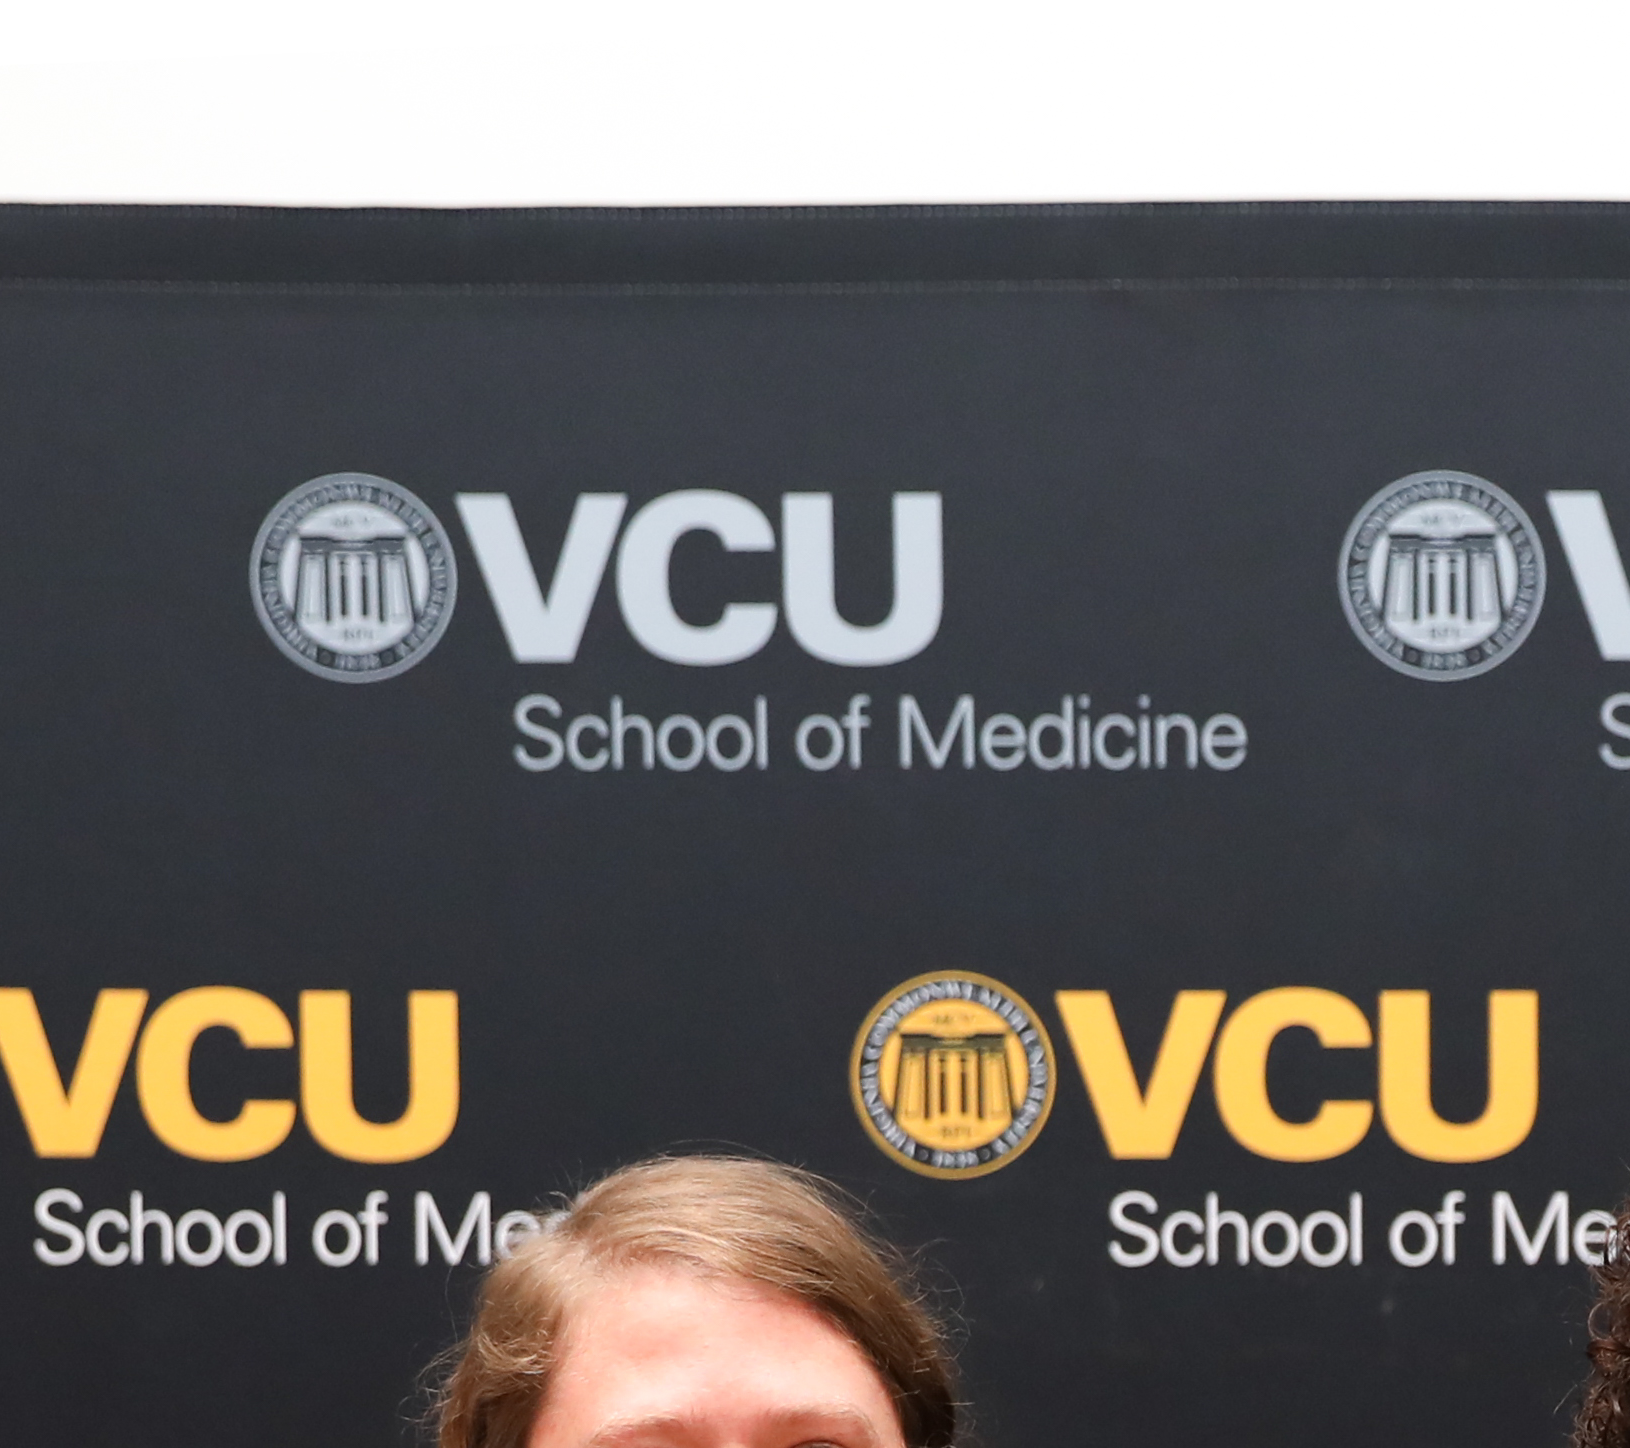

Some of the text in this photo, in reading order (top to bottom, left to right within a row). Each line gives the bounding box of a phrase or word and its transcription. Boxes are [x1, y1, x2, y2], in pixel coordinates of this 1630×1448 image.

[455, 489, 943, 668] VCU
[514, 694, 1248, 771] School of Medicine
[1055, 986, 1539, 1163] VCU
[34, 1188, 287, 1267] School
[312, 1190, 389, 1267] of
[1109, 1190, 1363, 1267] School
[1388, 1190, 1466, 1267] of
